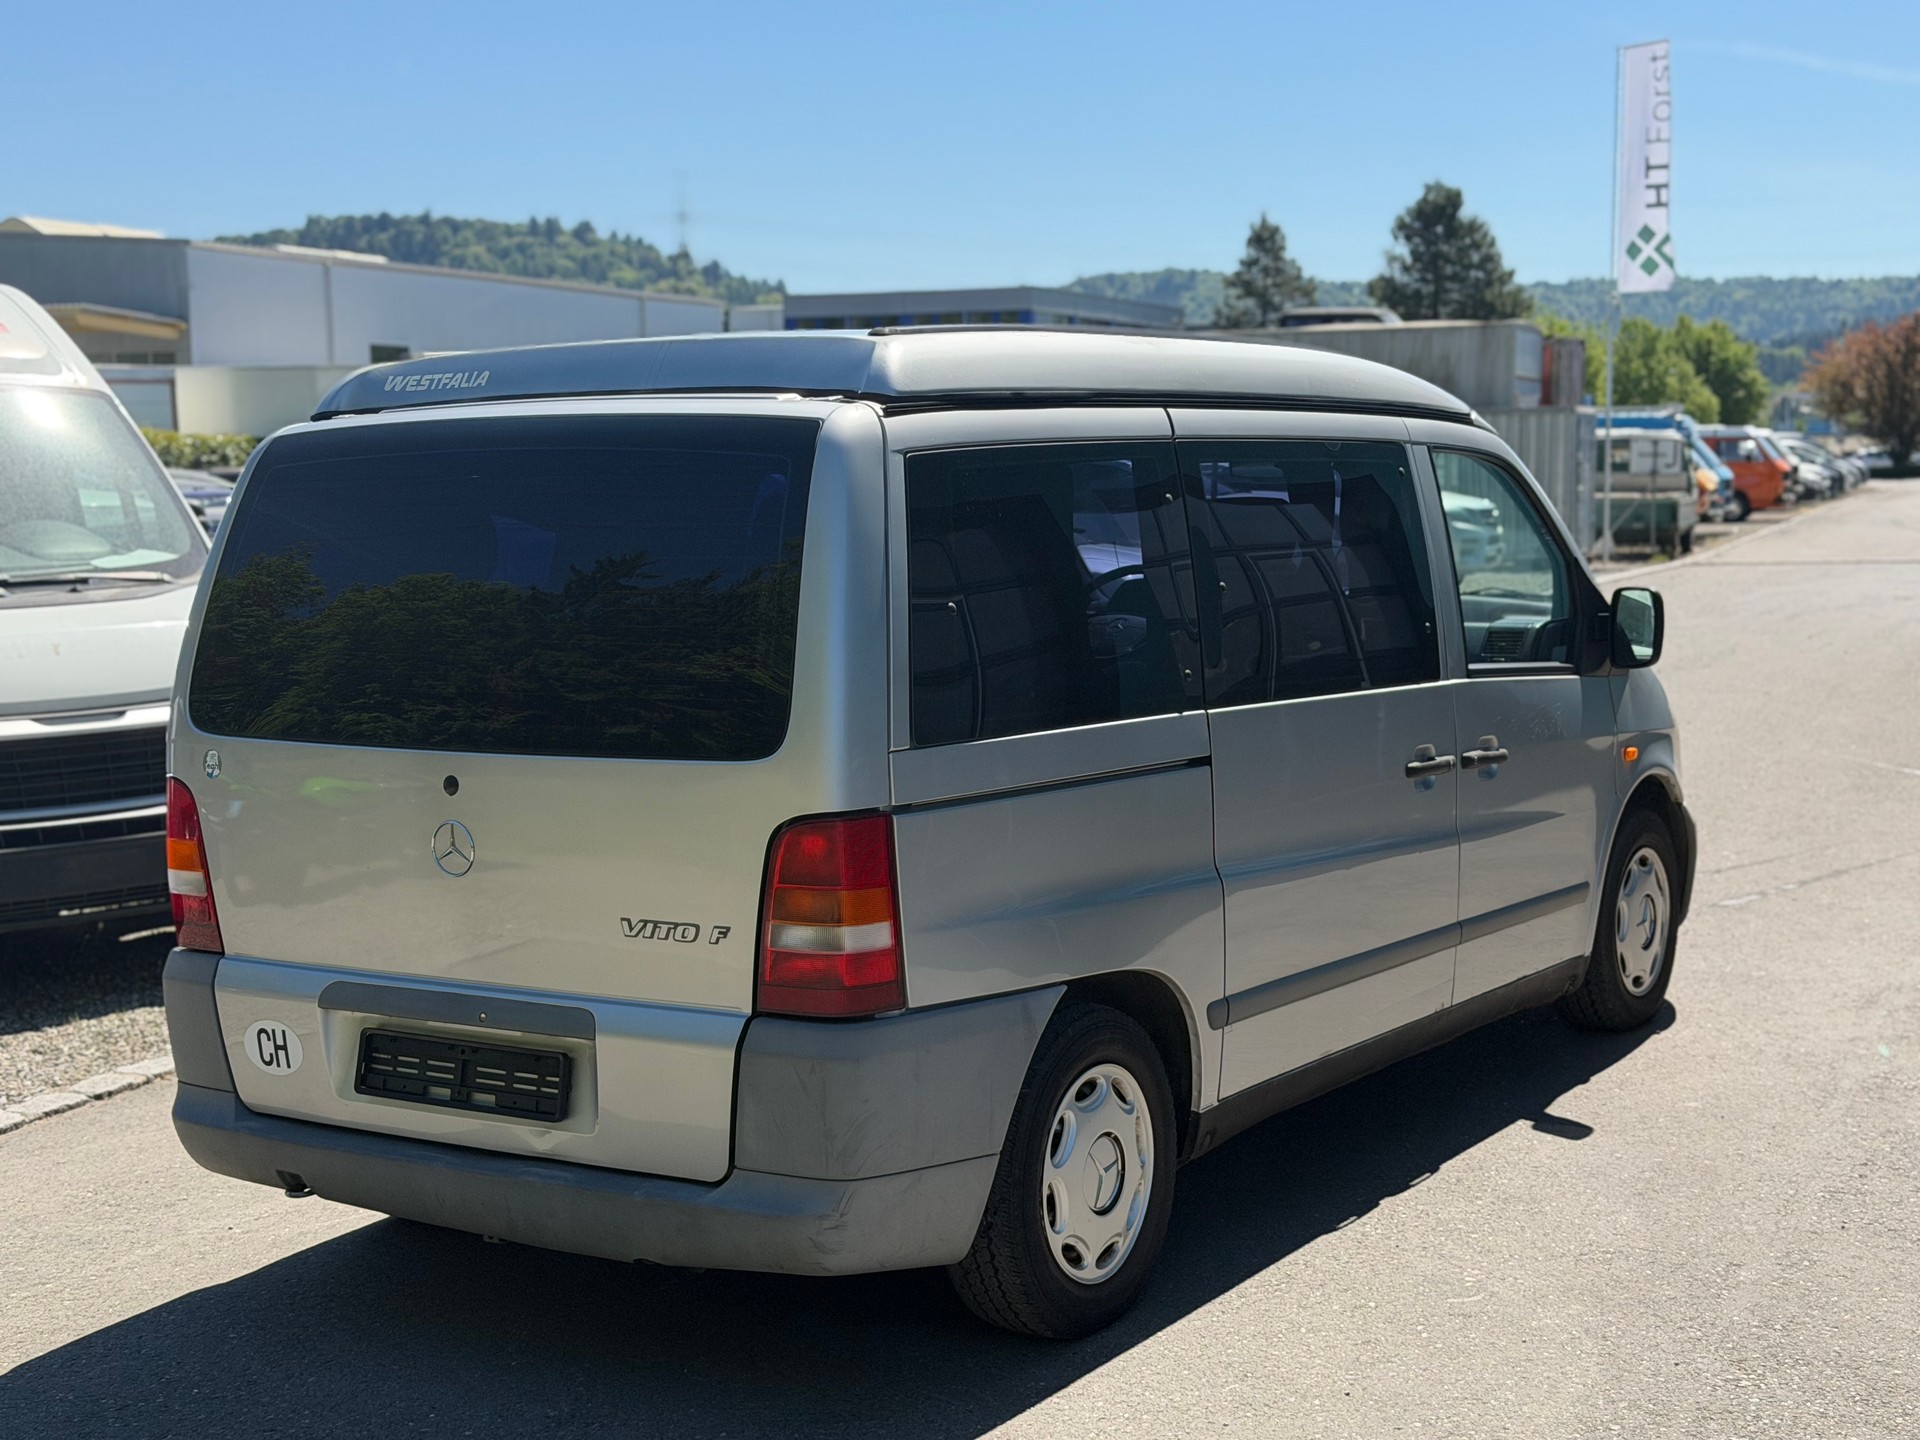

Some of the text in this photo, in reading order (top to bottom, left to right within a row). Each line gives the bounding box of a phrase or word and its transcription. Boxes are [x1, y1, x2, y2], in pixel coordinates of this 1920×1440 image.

[1645, 50, 1671, 209] HT Forst
[384, 370, 490, 392] WESTFALIA
[620, 917, 731, 945] VITO F
[256, 1027, 292, 1070] CH
